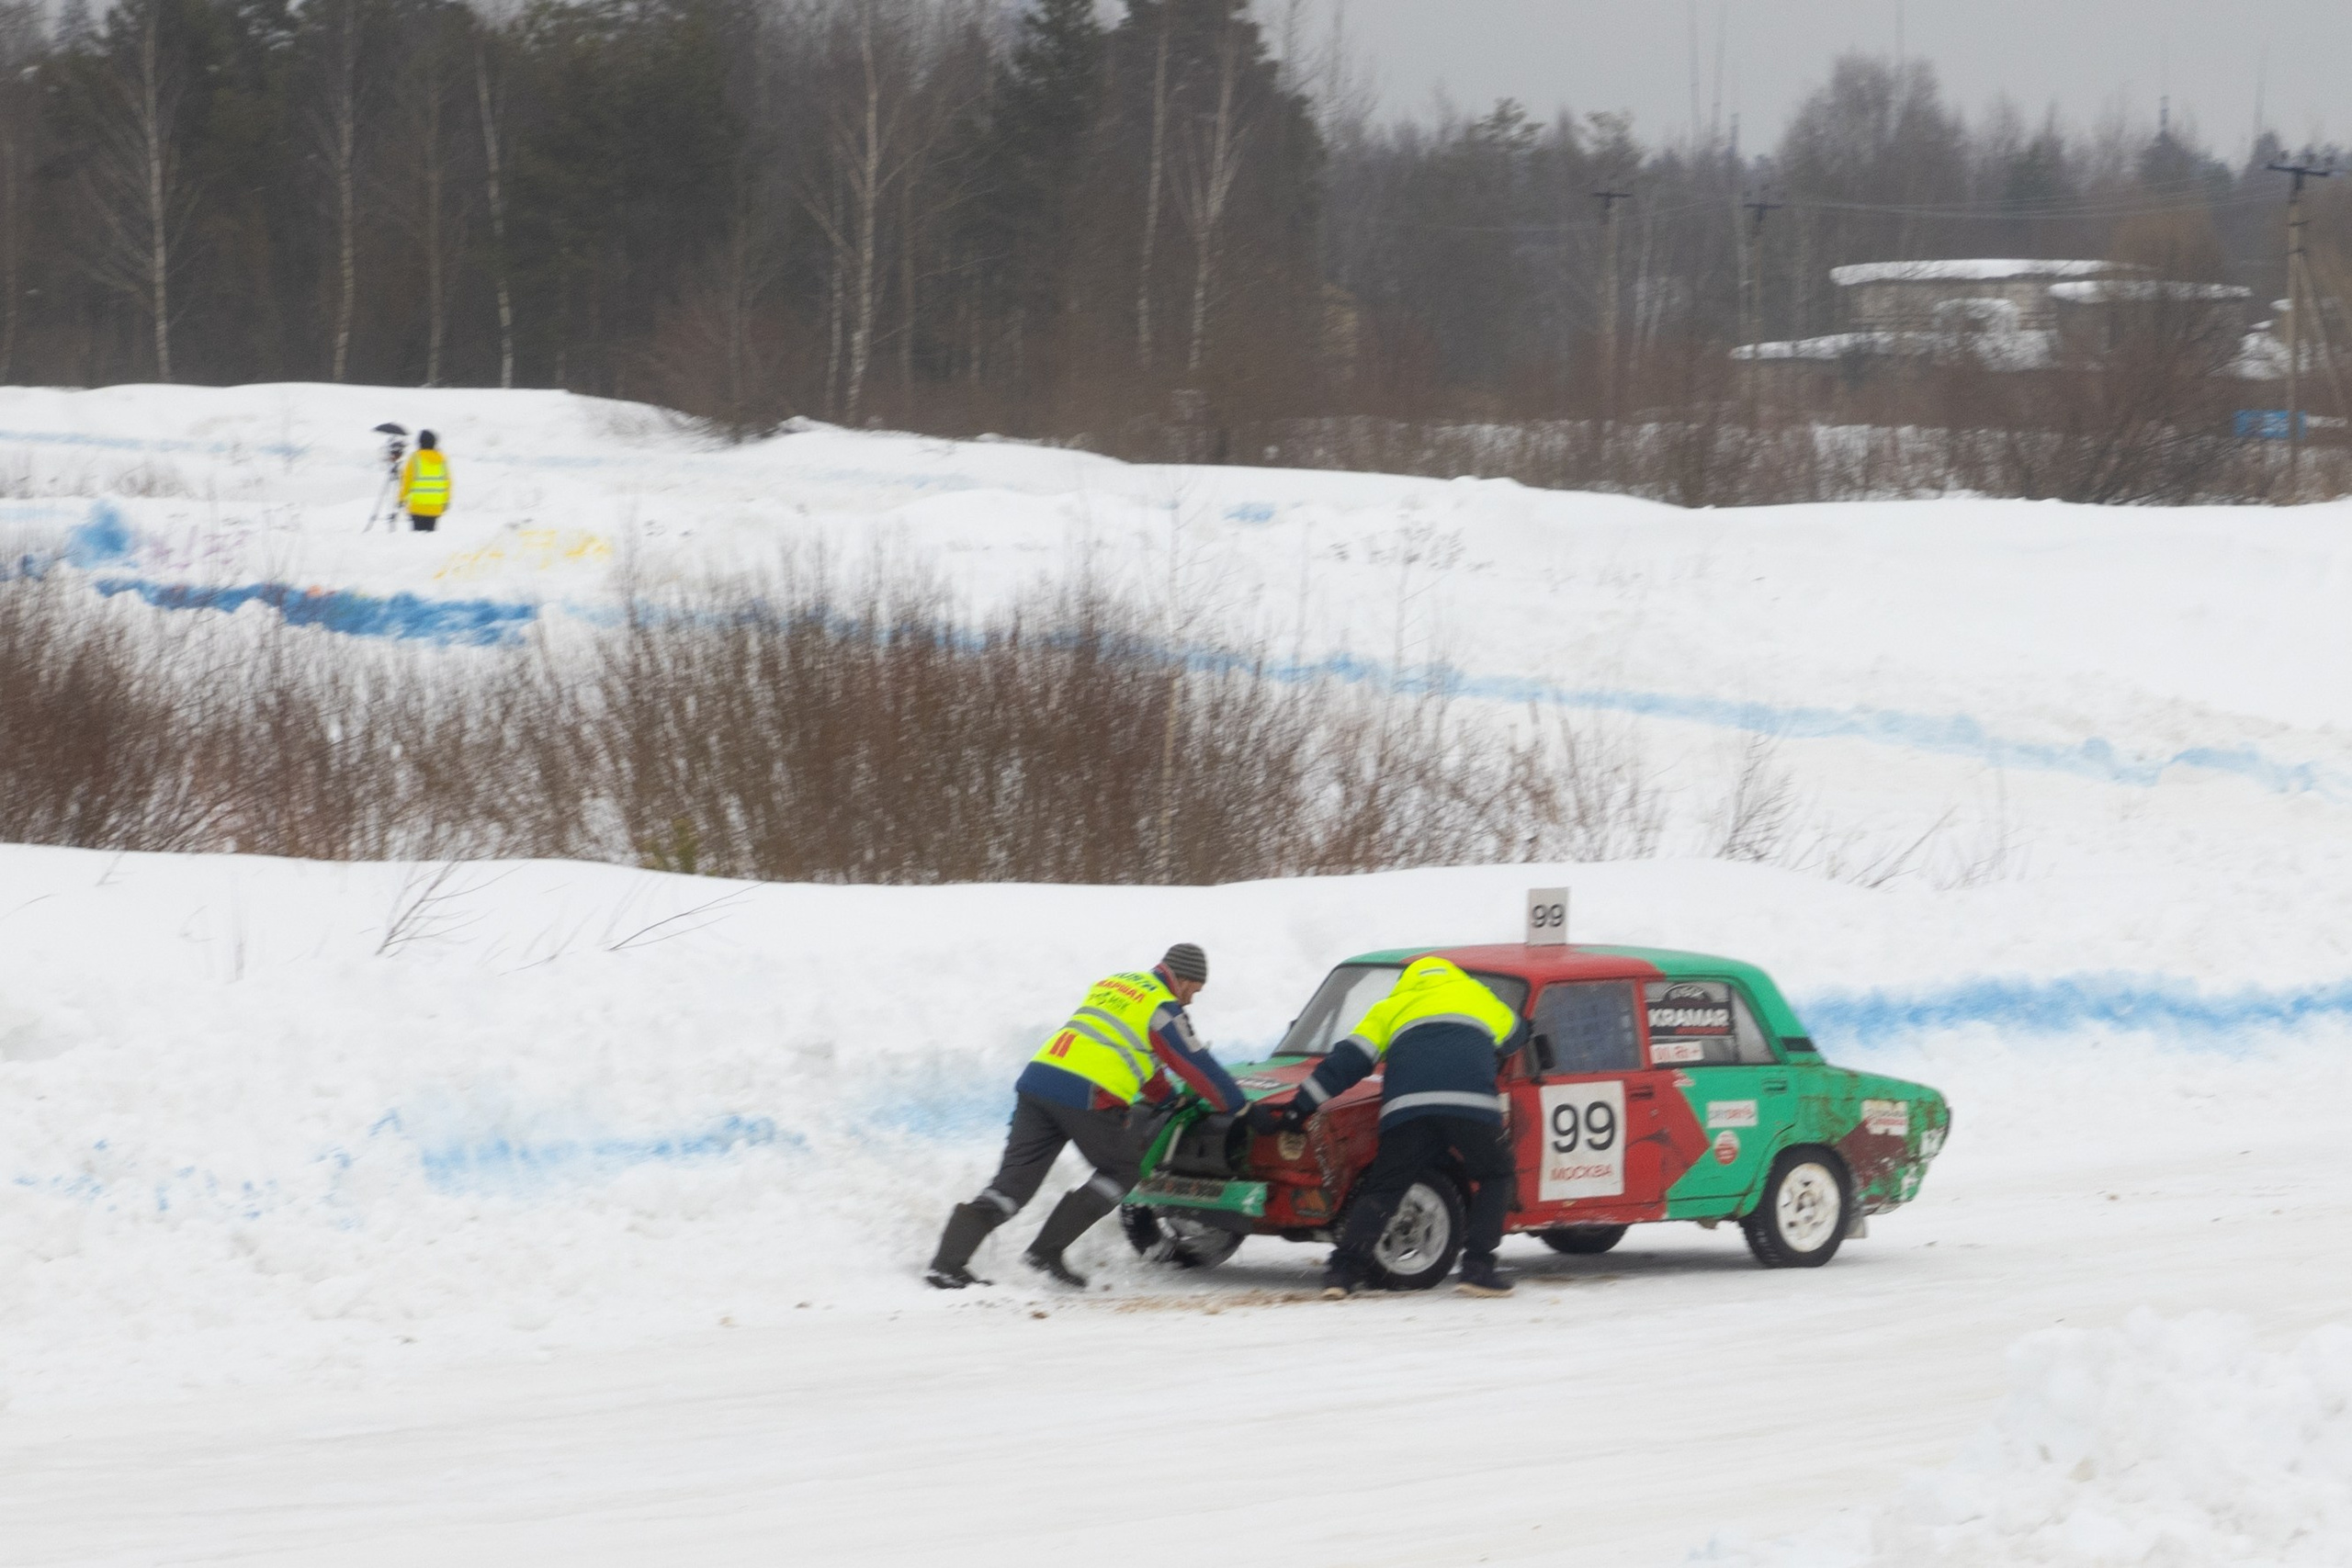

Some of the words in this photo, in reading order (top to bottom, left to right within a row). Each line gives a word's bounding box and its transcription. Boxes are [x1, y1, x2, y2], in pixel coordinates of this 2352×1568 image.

[1531, 903, 1566, 928] 99
[1552, 1100, 1615, 1154] 99
[1549, 1164, 1613, 1182] МОСКВА
